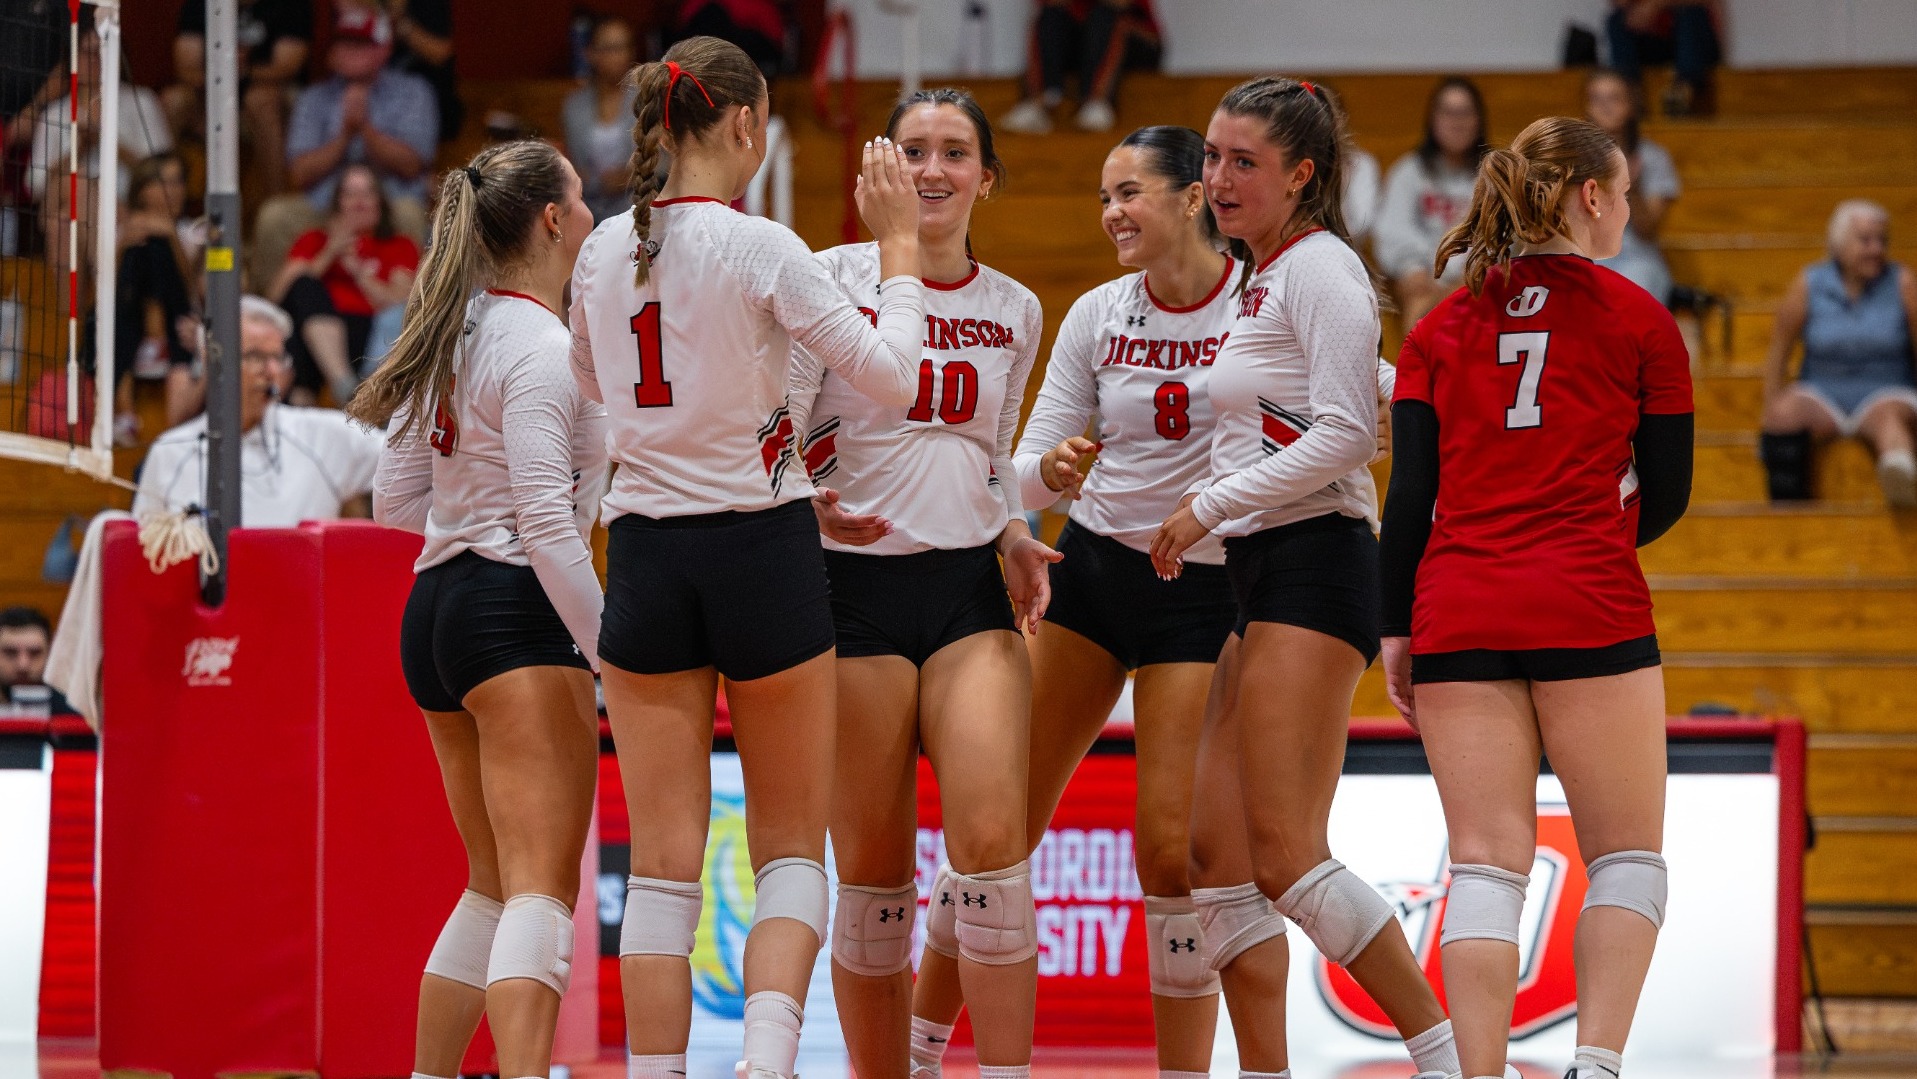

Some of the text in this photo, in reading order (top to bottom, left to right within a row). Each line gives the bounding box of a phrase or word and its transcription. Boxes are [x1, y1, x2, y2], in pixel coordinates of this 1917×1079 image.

[630, 301, 673, 408] 1
[857, 306, 1014, 350] INSON
[1101, 331, 1230, 371] ICKINS
[907, 359, 978, 425] 10
[1153, 381, 1190, 441] 8
[1497, 330, 1551, 430] 7
